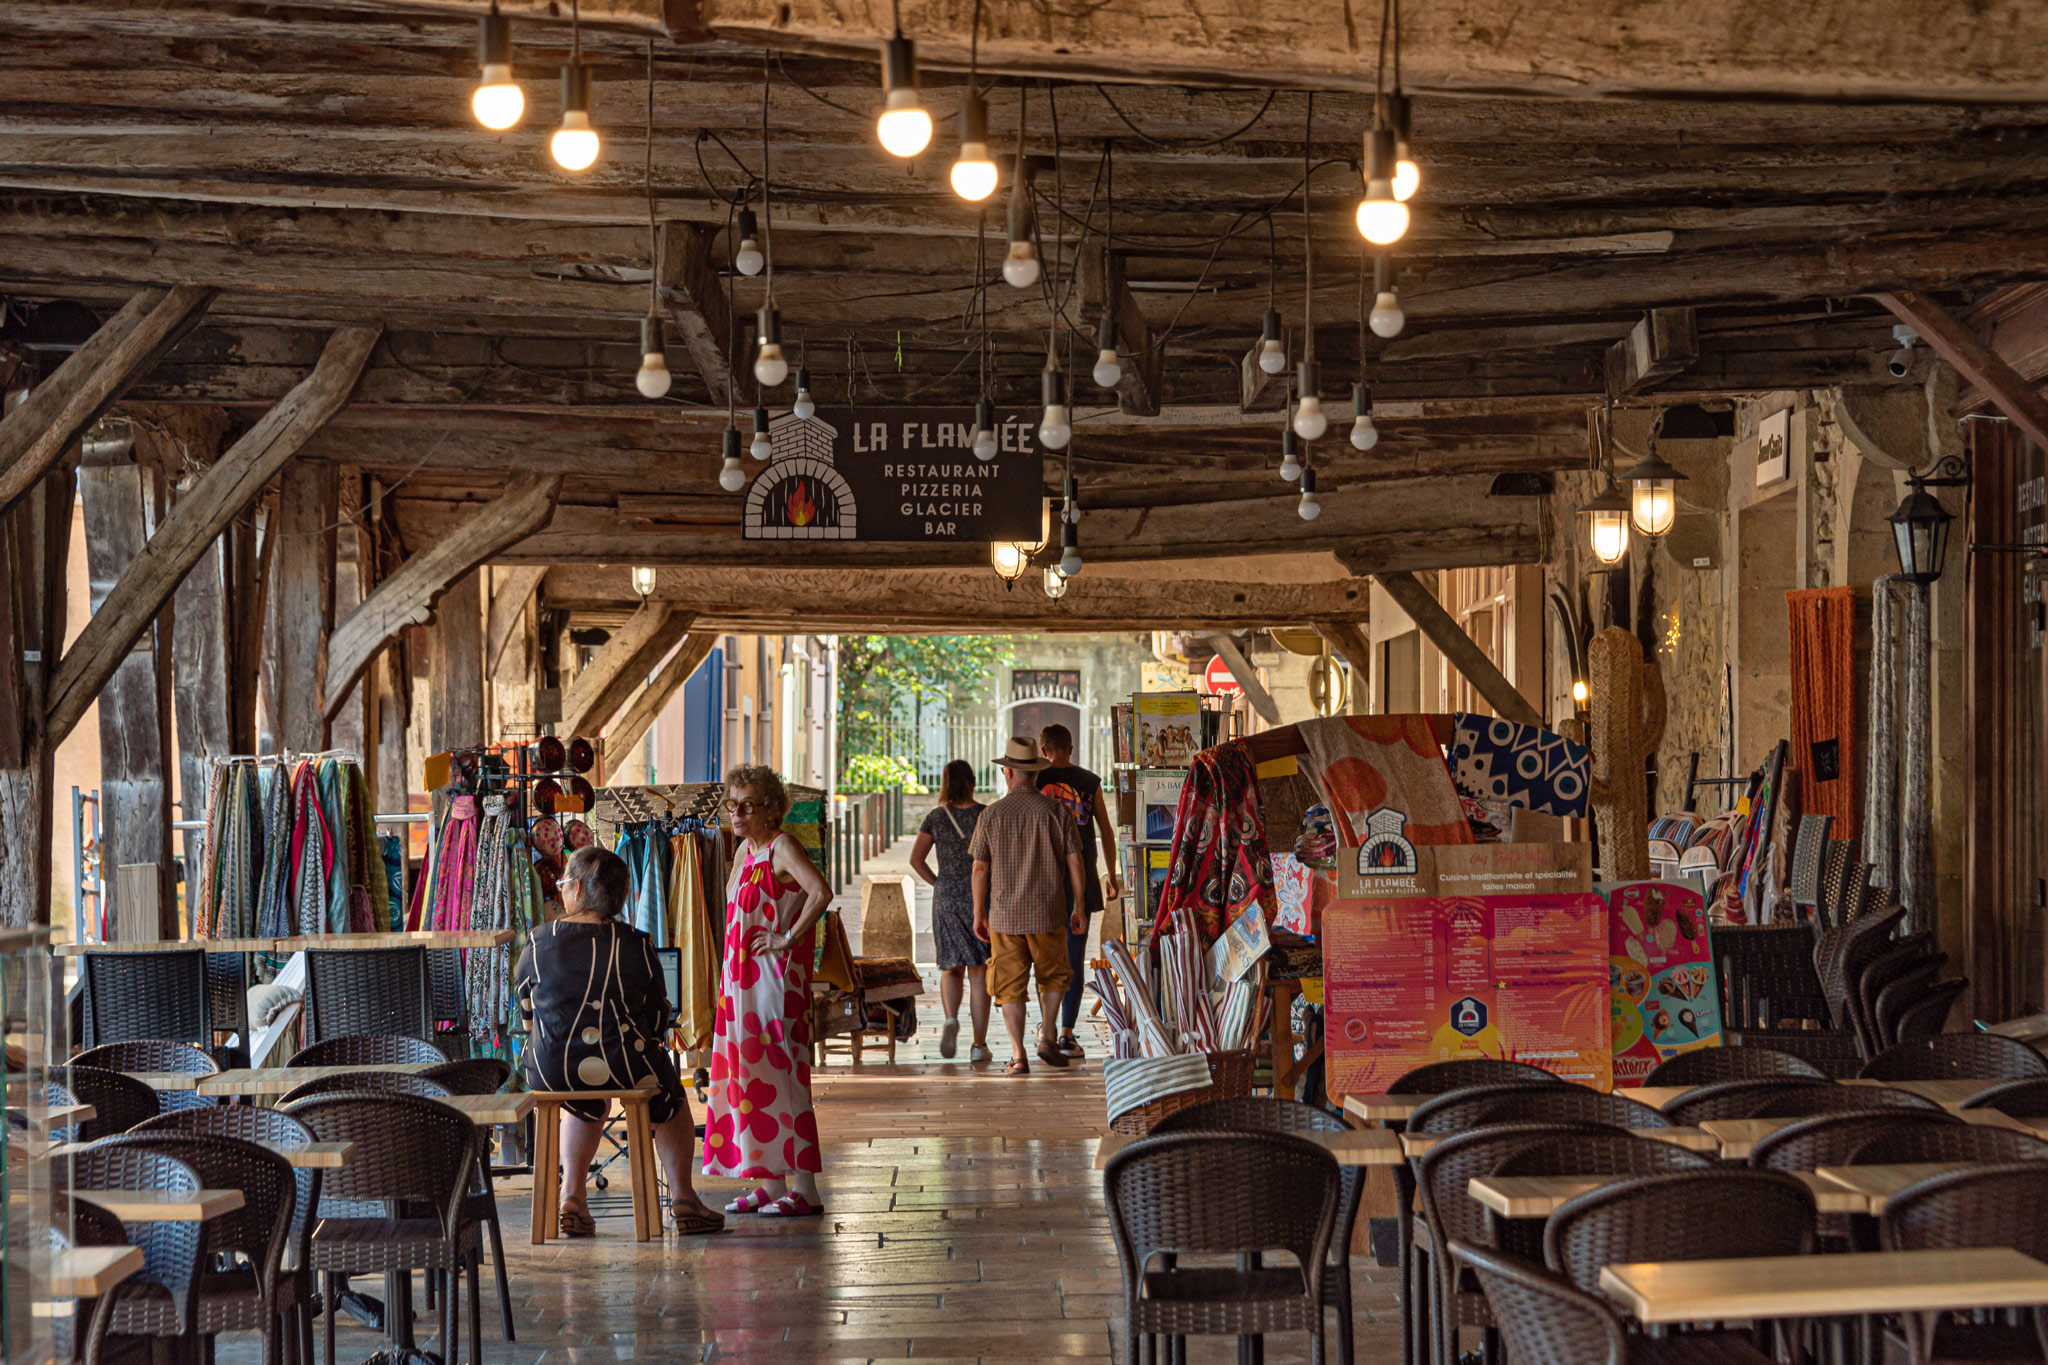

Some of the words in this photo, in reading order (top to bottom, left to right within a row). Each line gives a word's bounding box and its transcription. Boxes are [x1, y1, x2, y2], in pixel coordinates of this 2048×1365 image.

[853, 422, 887, 453] LA
[902, 415, 1034, 454] FLAMÉE
[884, 464, 1000, 478] RESTAURANT
[901, 483, 983, 497] PIZZERIA
[901, 503, 983, 517] GLACIER
[924, 522, 956, 536] BAR
[1439, 873, 1469, 881] Cuisine
[1470, 872, 1523, 881] traditionnelle
[1535, 869, 1577, 880] spécialités
[1359, 878, 1372, 889] LA
[1375, 876, 1417, 888] FLAMBÉE
[1482, 883, 1504, 891] faites
[1505, 882, 1536, 890] maison
[1612, 1057, 1651, 1077] Astérix
